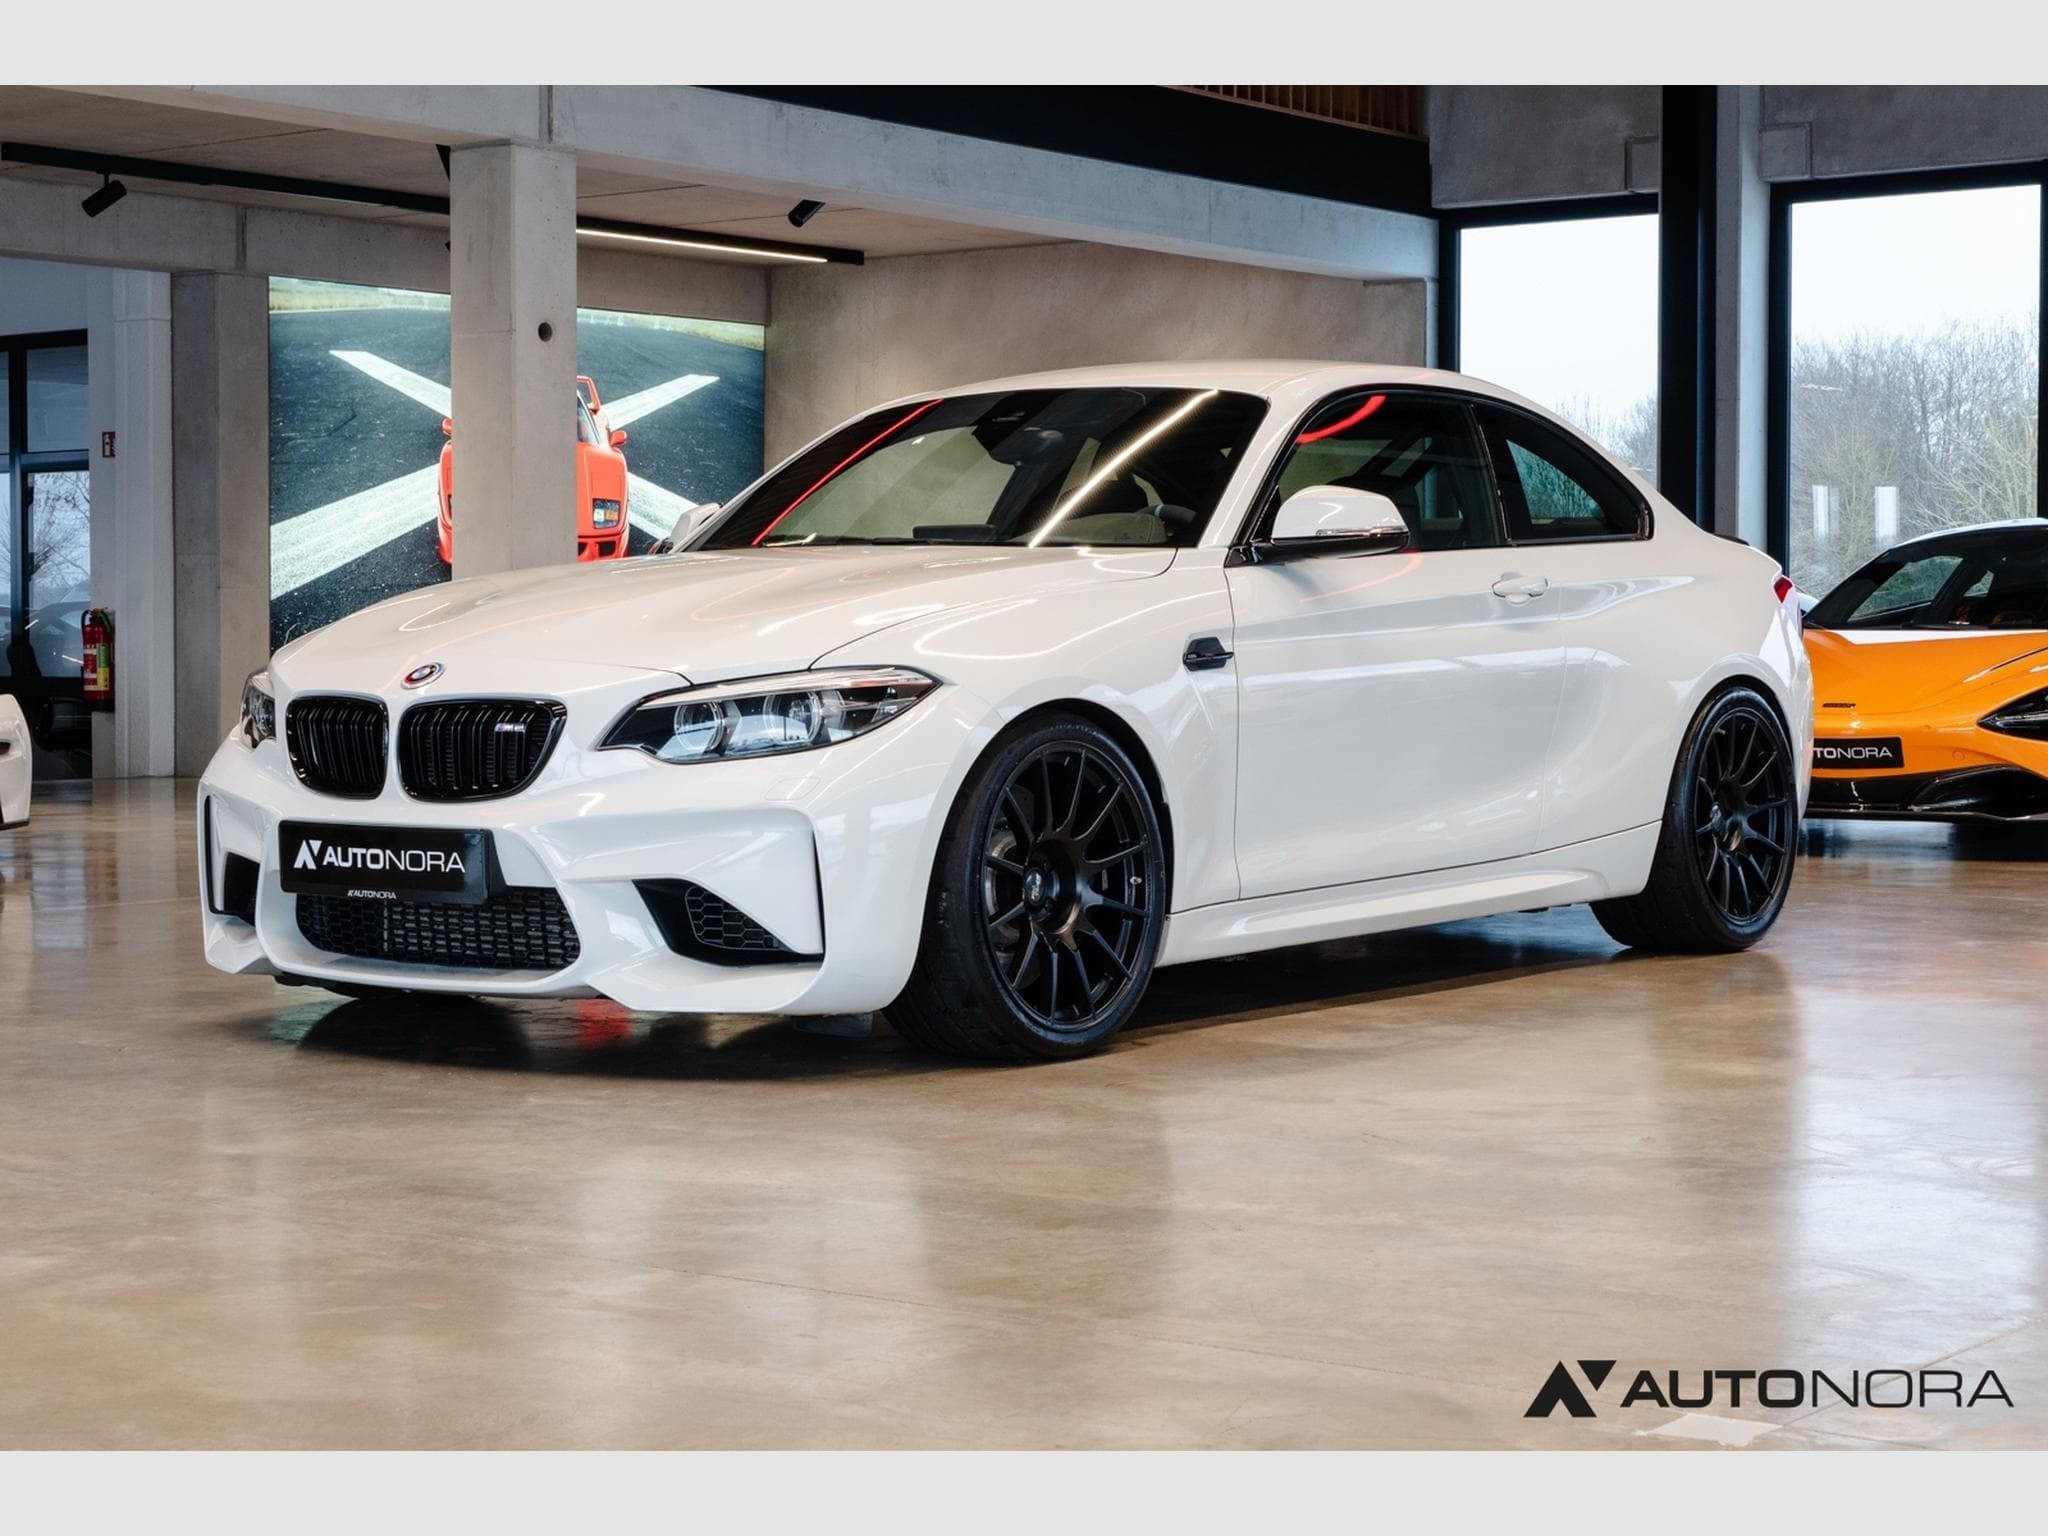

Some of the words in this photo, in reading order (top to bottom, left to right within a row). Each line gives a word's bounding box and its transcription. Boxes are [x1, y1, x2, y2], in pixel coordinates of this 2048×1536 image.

[1813, 747, 1893, 759] TONORA
[322, 846, 466, 873] AUTONORA
[353, 889, 397, 900] AUTONORA
